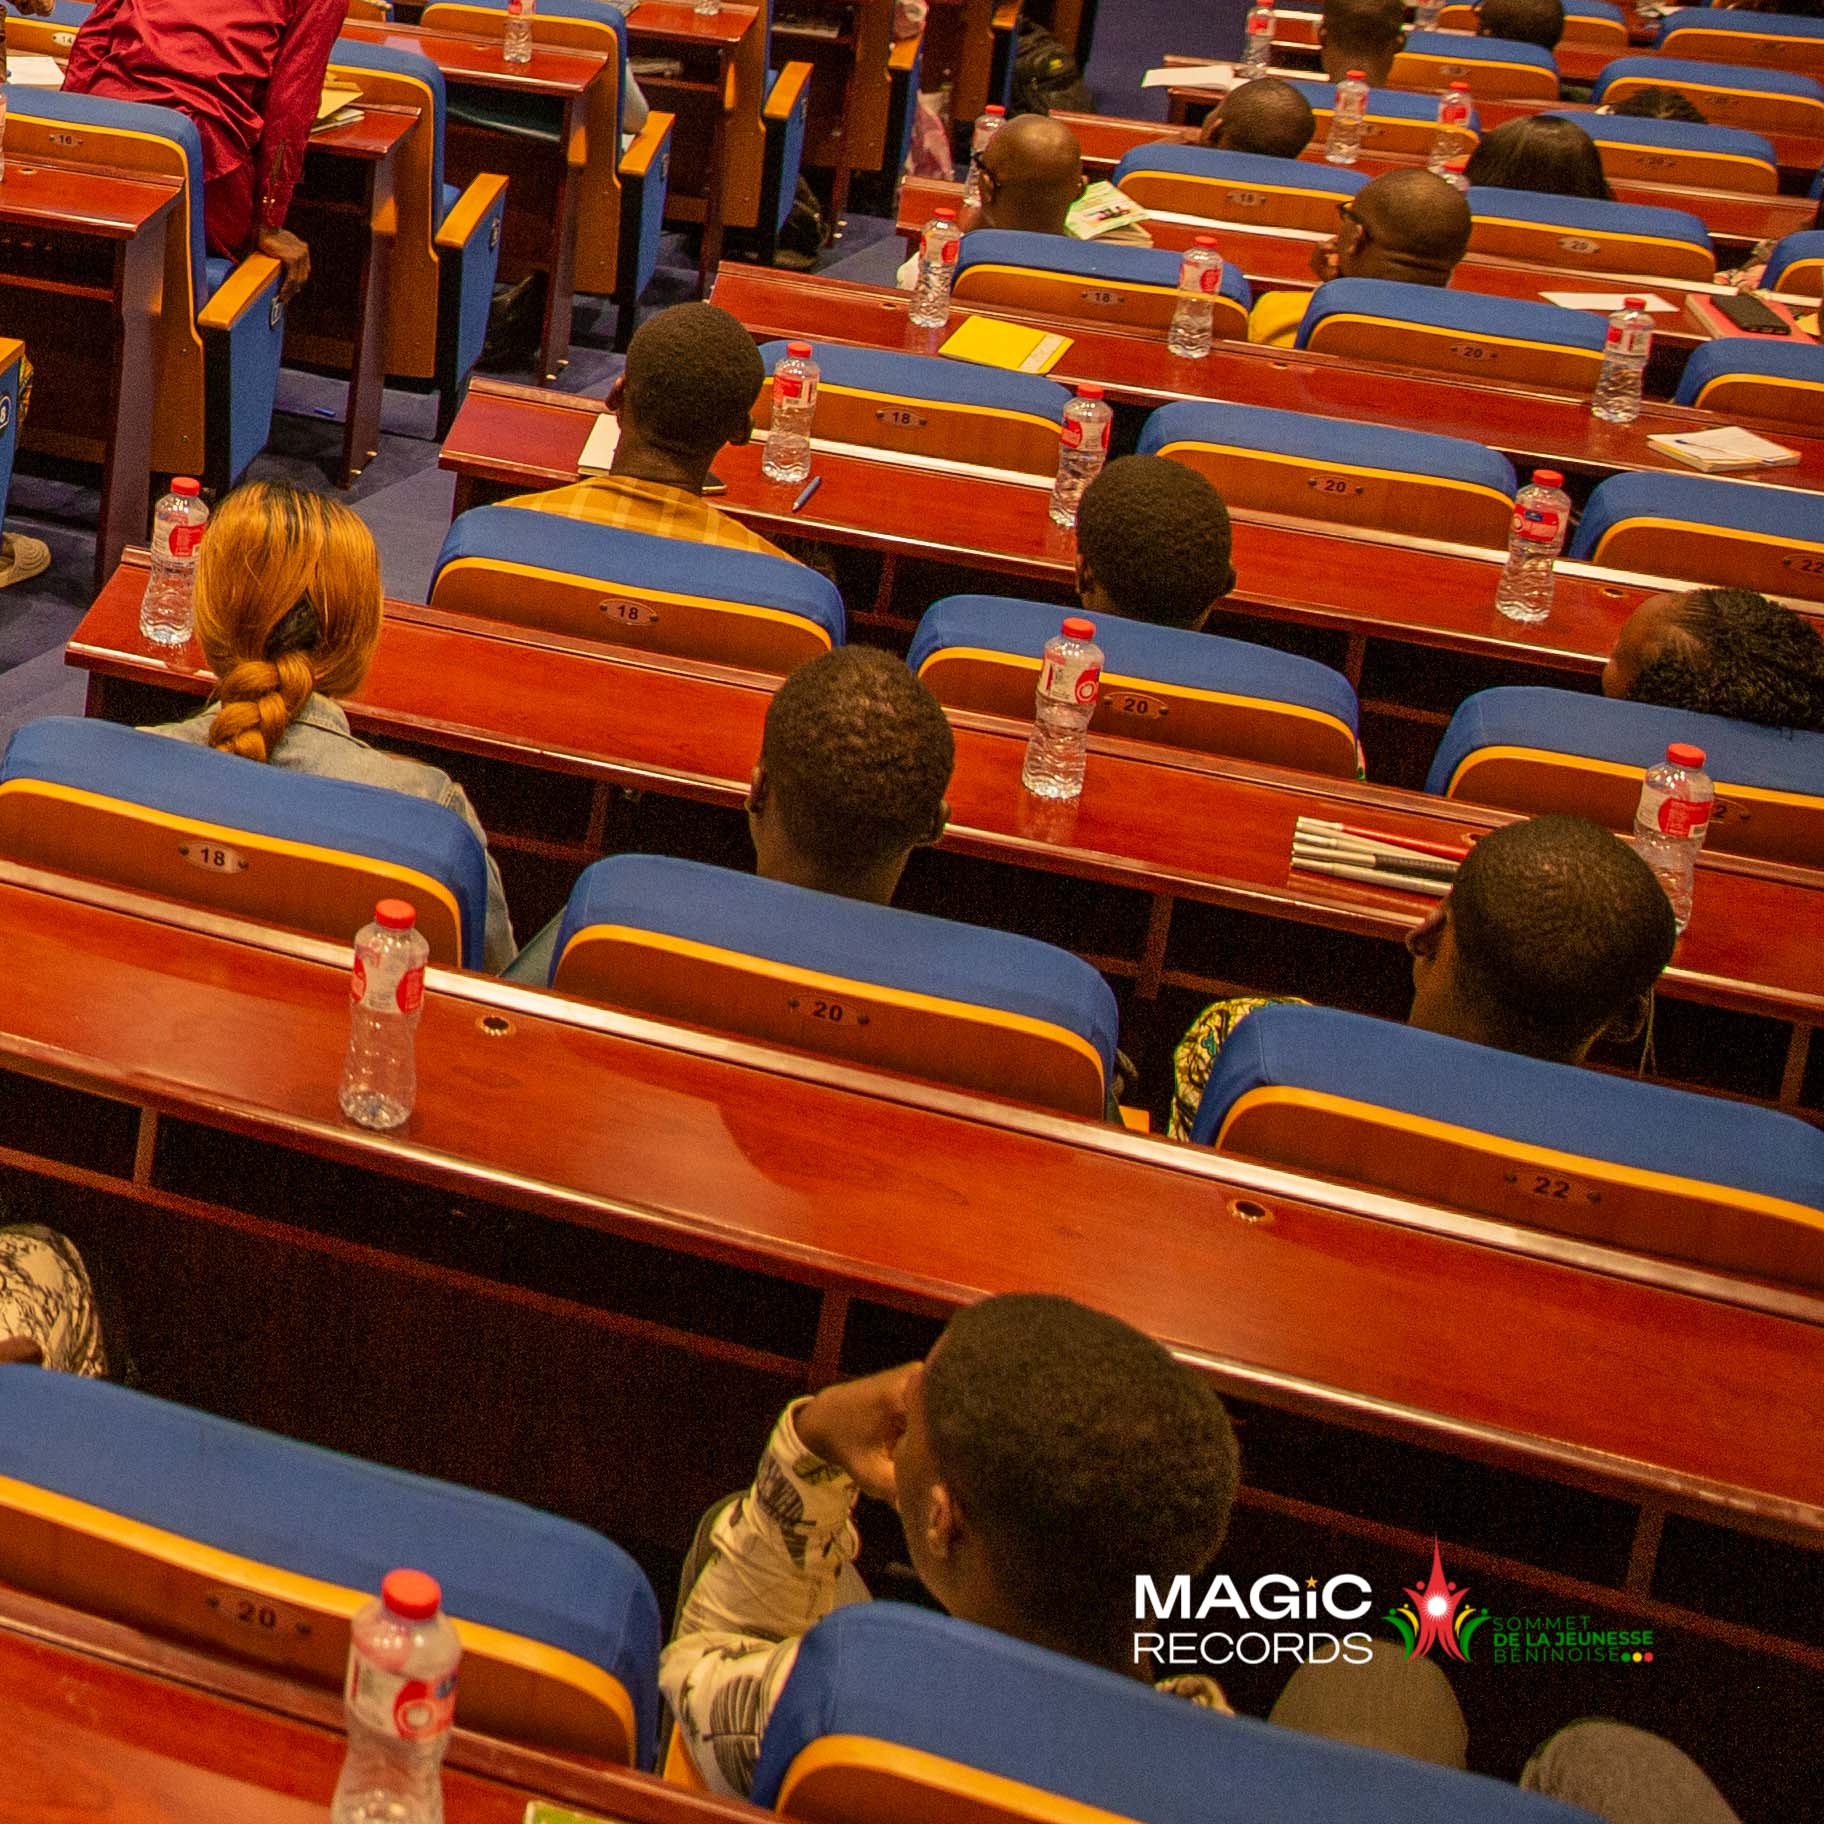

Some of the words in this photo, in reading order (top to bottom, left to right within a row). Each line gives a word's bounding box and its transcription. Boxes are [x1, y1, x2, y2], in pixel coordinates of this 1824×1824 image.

[1095, 292, 1110, 303] 18
[1464, 347, 1483, 359] 20
[892, 412, 910, 424] 18
[1325, 480, 1346, 493] 20
[1801, 559, 1824, 573] 22
[617, 606, 639, 621] 18
[1123, 697, 1148, 715] 20
[200, 847, 225, 866] 18
[812, 1000, 843, 1022] 20
[1534, 1175, 1570, 1200] 22
[238, 1599, 277, 1627] 20
